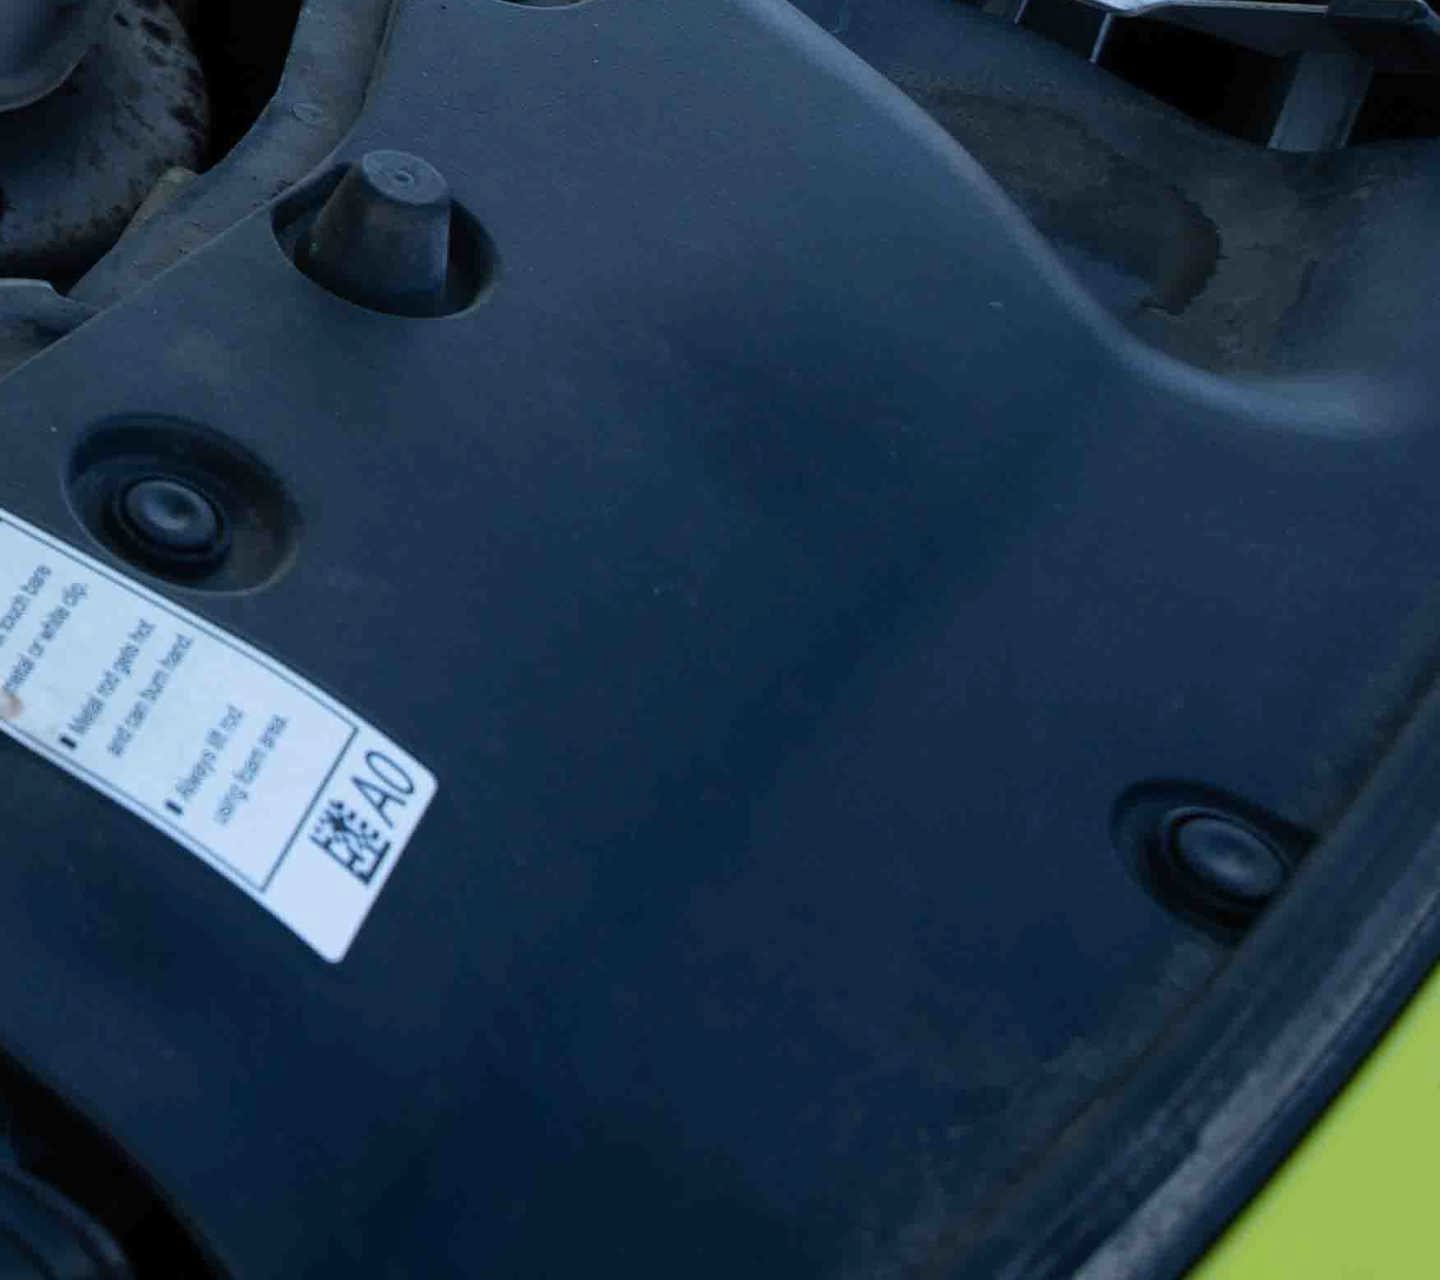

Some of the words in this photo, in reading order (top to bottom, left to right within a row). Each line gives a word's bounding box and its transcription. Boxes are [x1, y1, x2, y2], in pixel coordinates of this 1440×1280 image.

[20, 565, 51, 596] bare
[41, 605, 70, 640] white
[68, 694, 103, 735] Metal
[113, 642, 139, 675] gets
[106, 724, 132, 757] and
[139, 669, 169, 702] burn
[176, 748, 217, 800] Always
